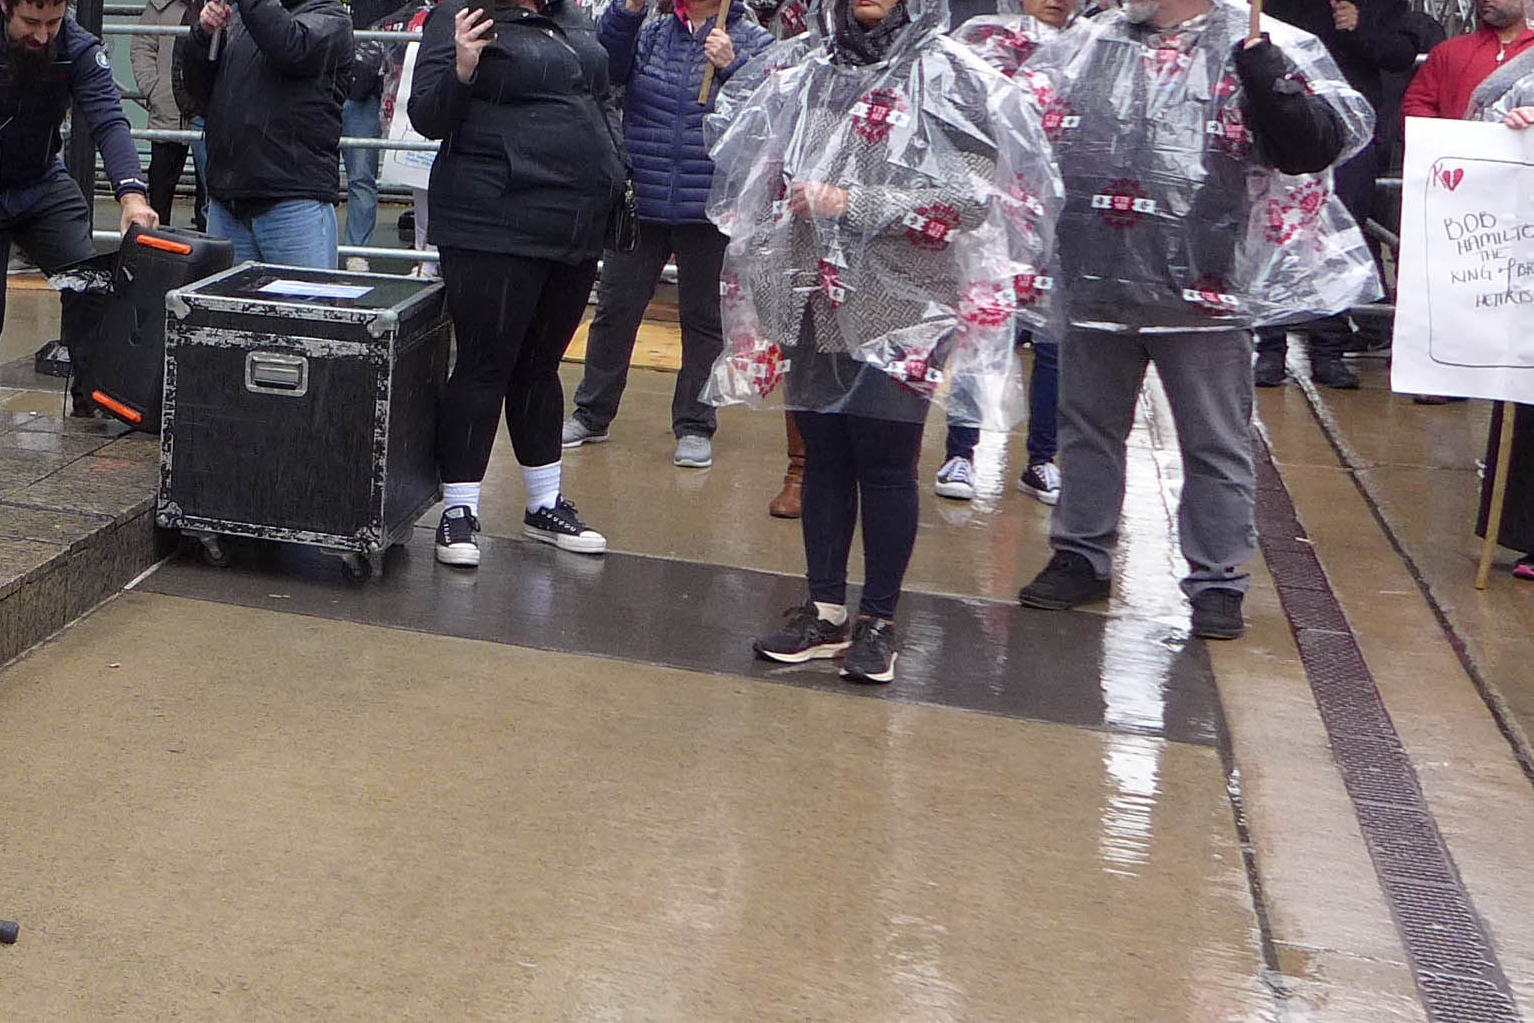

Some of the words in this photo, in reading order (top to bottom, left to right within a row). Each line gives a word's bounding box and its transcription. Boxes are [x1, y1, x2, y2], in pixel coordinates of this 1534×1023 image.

[1443, 211, 1497, 240] BOB
[1474, 245, 1509, 263] THE
[1451, 263, 1492, 284] KING
